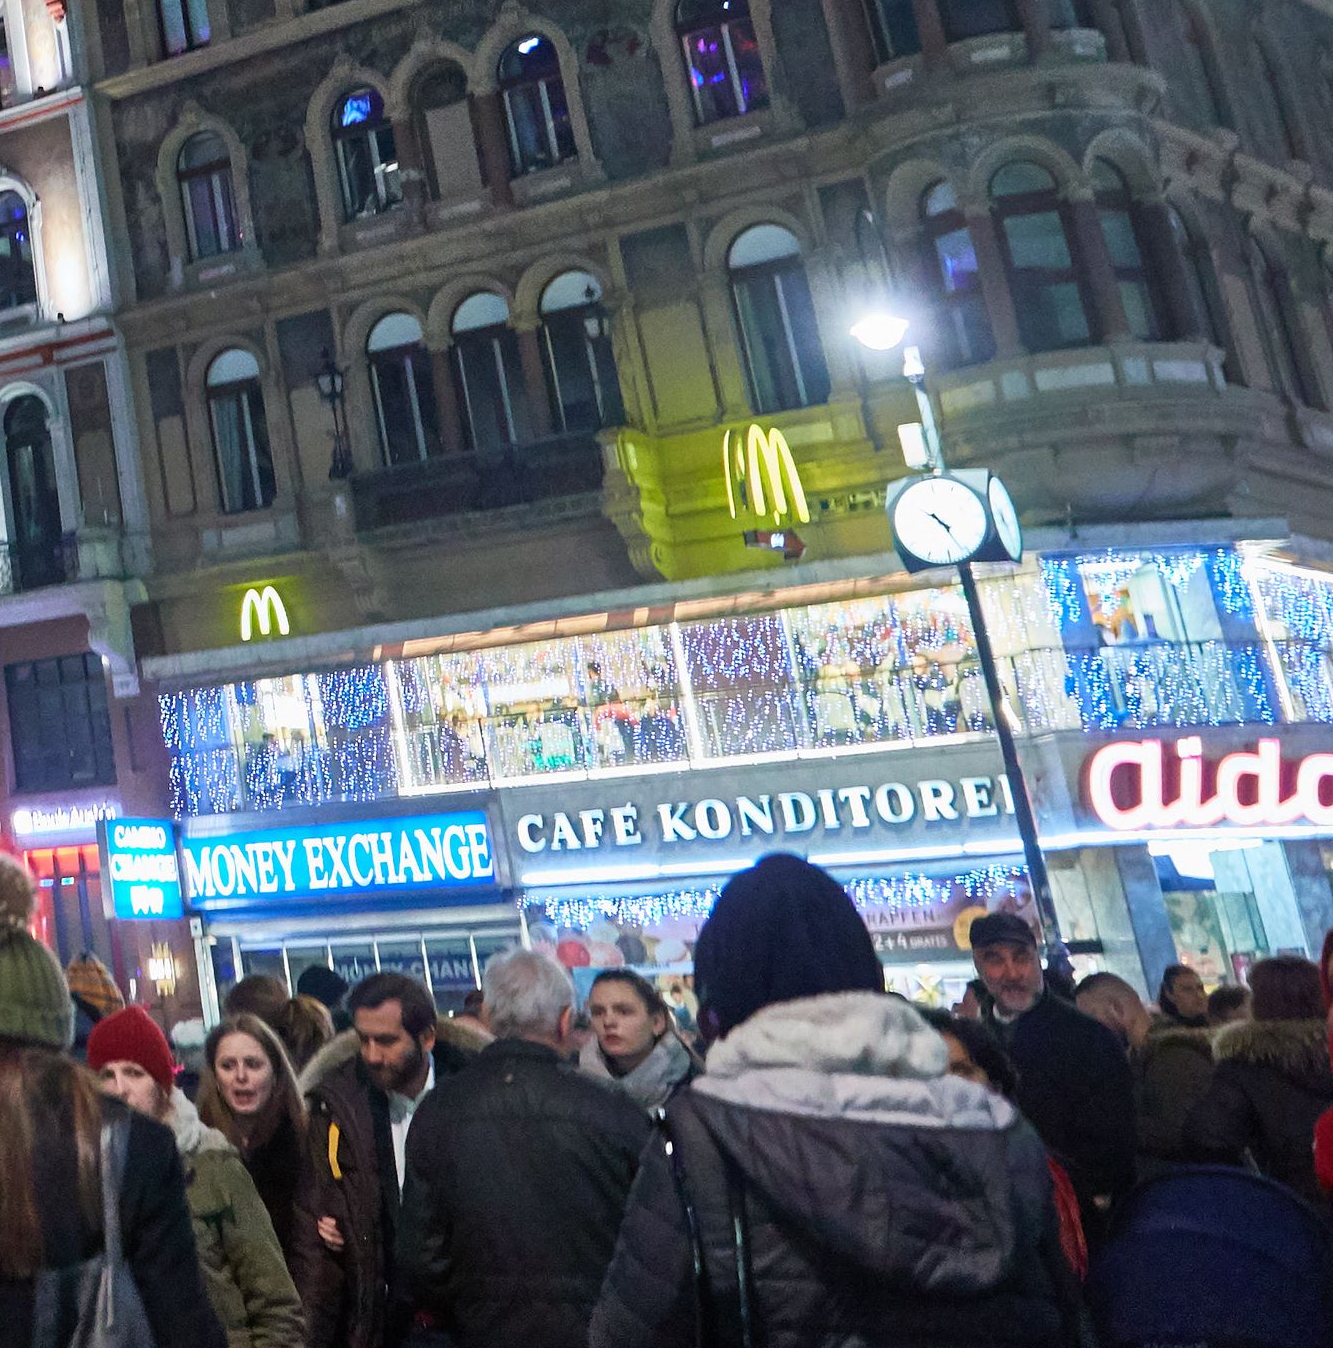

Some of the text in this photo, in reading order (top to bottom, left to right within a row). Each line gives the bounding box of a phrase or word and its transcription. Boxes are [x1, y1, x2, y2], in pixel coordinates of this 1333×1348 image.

[517, 774, 1016, 852] CAFÉ KONDITOREI
[183, 823, 493, 898] MONEY EXCHANGE
